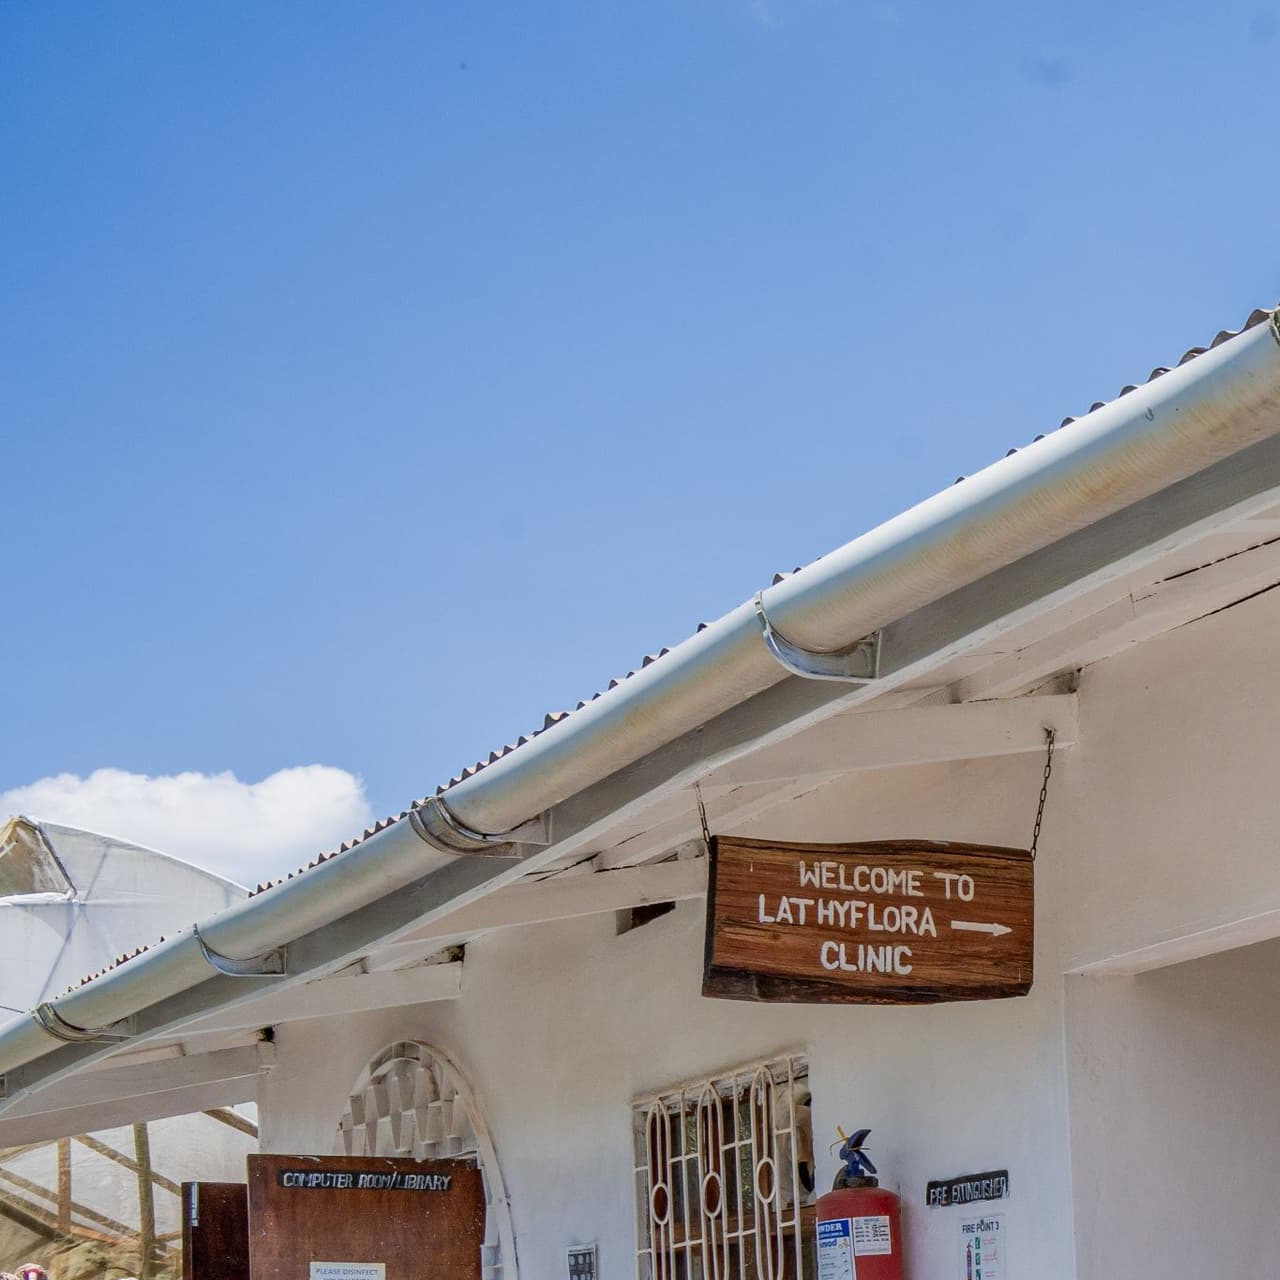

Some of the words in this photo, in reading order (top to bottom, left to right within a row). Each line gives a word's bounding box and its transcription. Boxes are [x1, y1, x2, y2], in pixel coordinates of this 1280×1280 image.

[800, 861, 924, 897] WELCOME
[933, 872, 975, 901] TO
[759, 894, 937, 938] LATHYFLORA
[820, 941, 913, 976] CLINIC
[283, 1172, 353, 1189] COMPUTER
[952, 1177, 1008, 1202] EXTINGUISHER
[962, 1223, 975, 1234] FIRE
[976, 1221, 994, 1232] POINT
[995, 1221, 1000, 1231] 3
